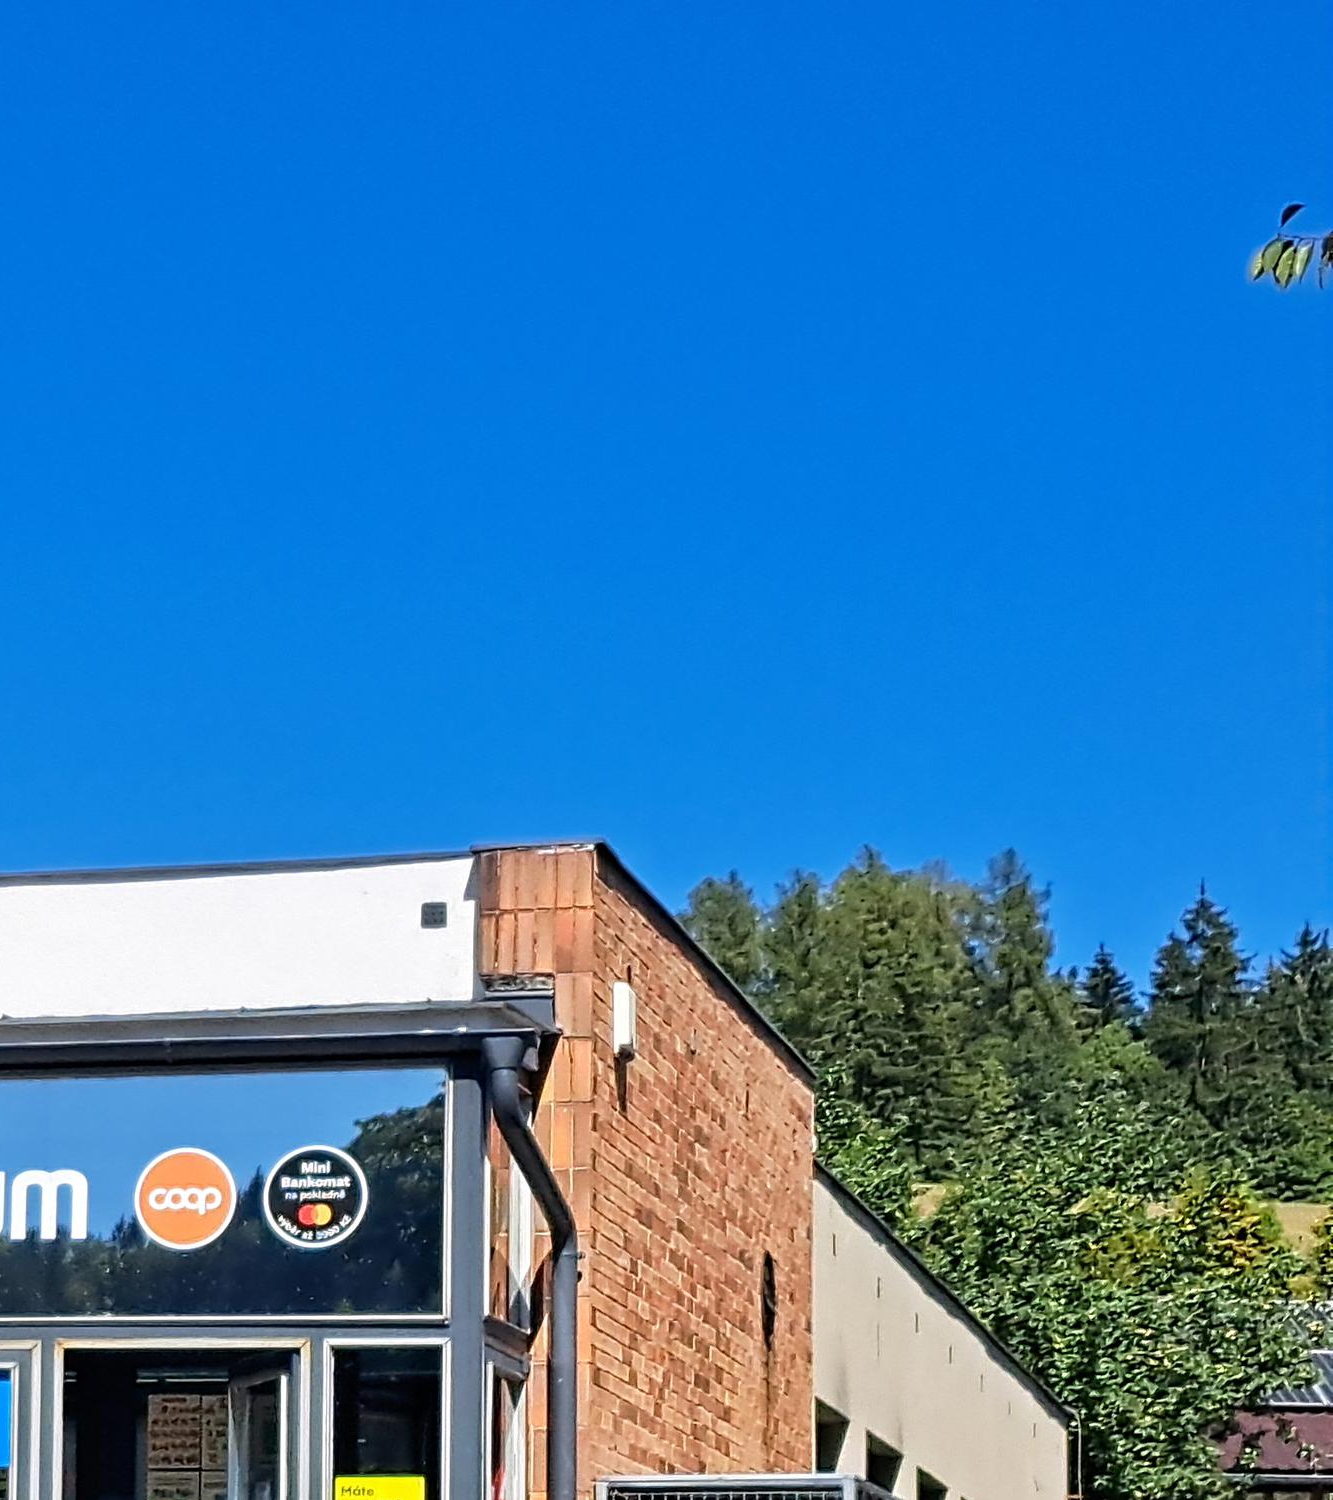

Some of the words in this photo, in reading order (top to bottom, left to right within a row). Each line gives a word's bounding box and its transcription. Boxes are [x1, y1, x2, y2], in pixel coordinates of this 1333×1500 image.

[301, 1161, 332, 1174] Mini
[280, 1176, 351, 1188] Bankomat
[148, 1186, 222, 1215] coop
[341, 1485, 374, 1497] Máte
